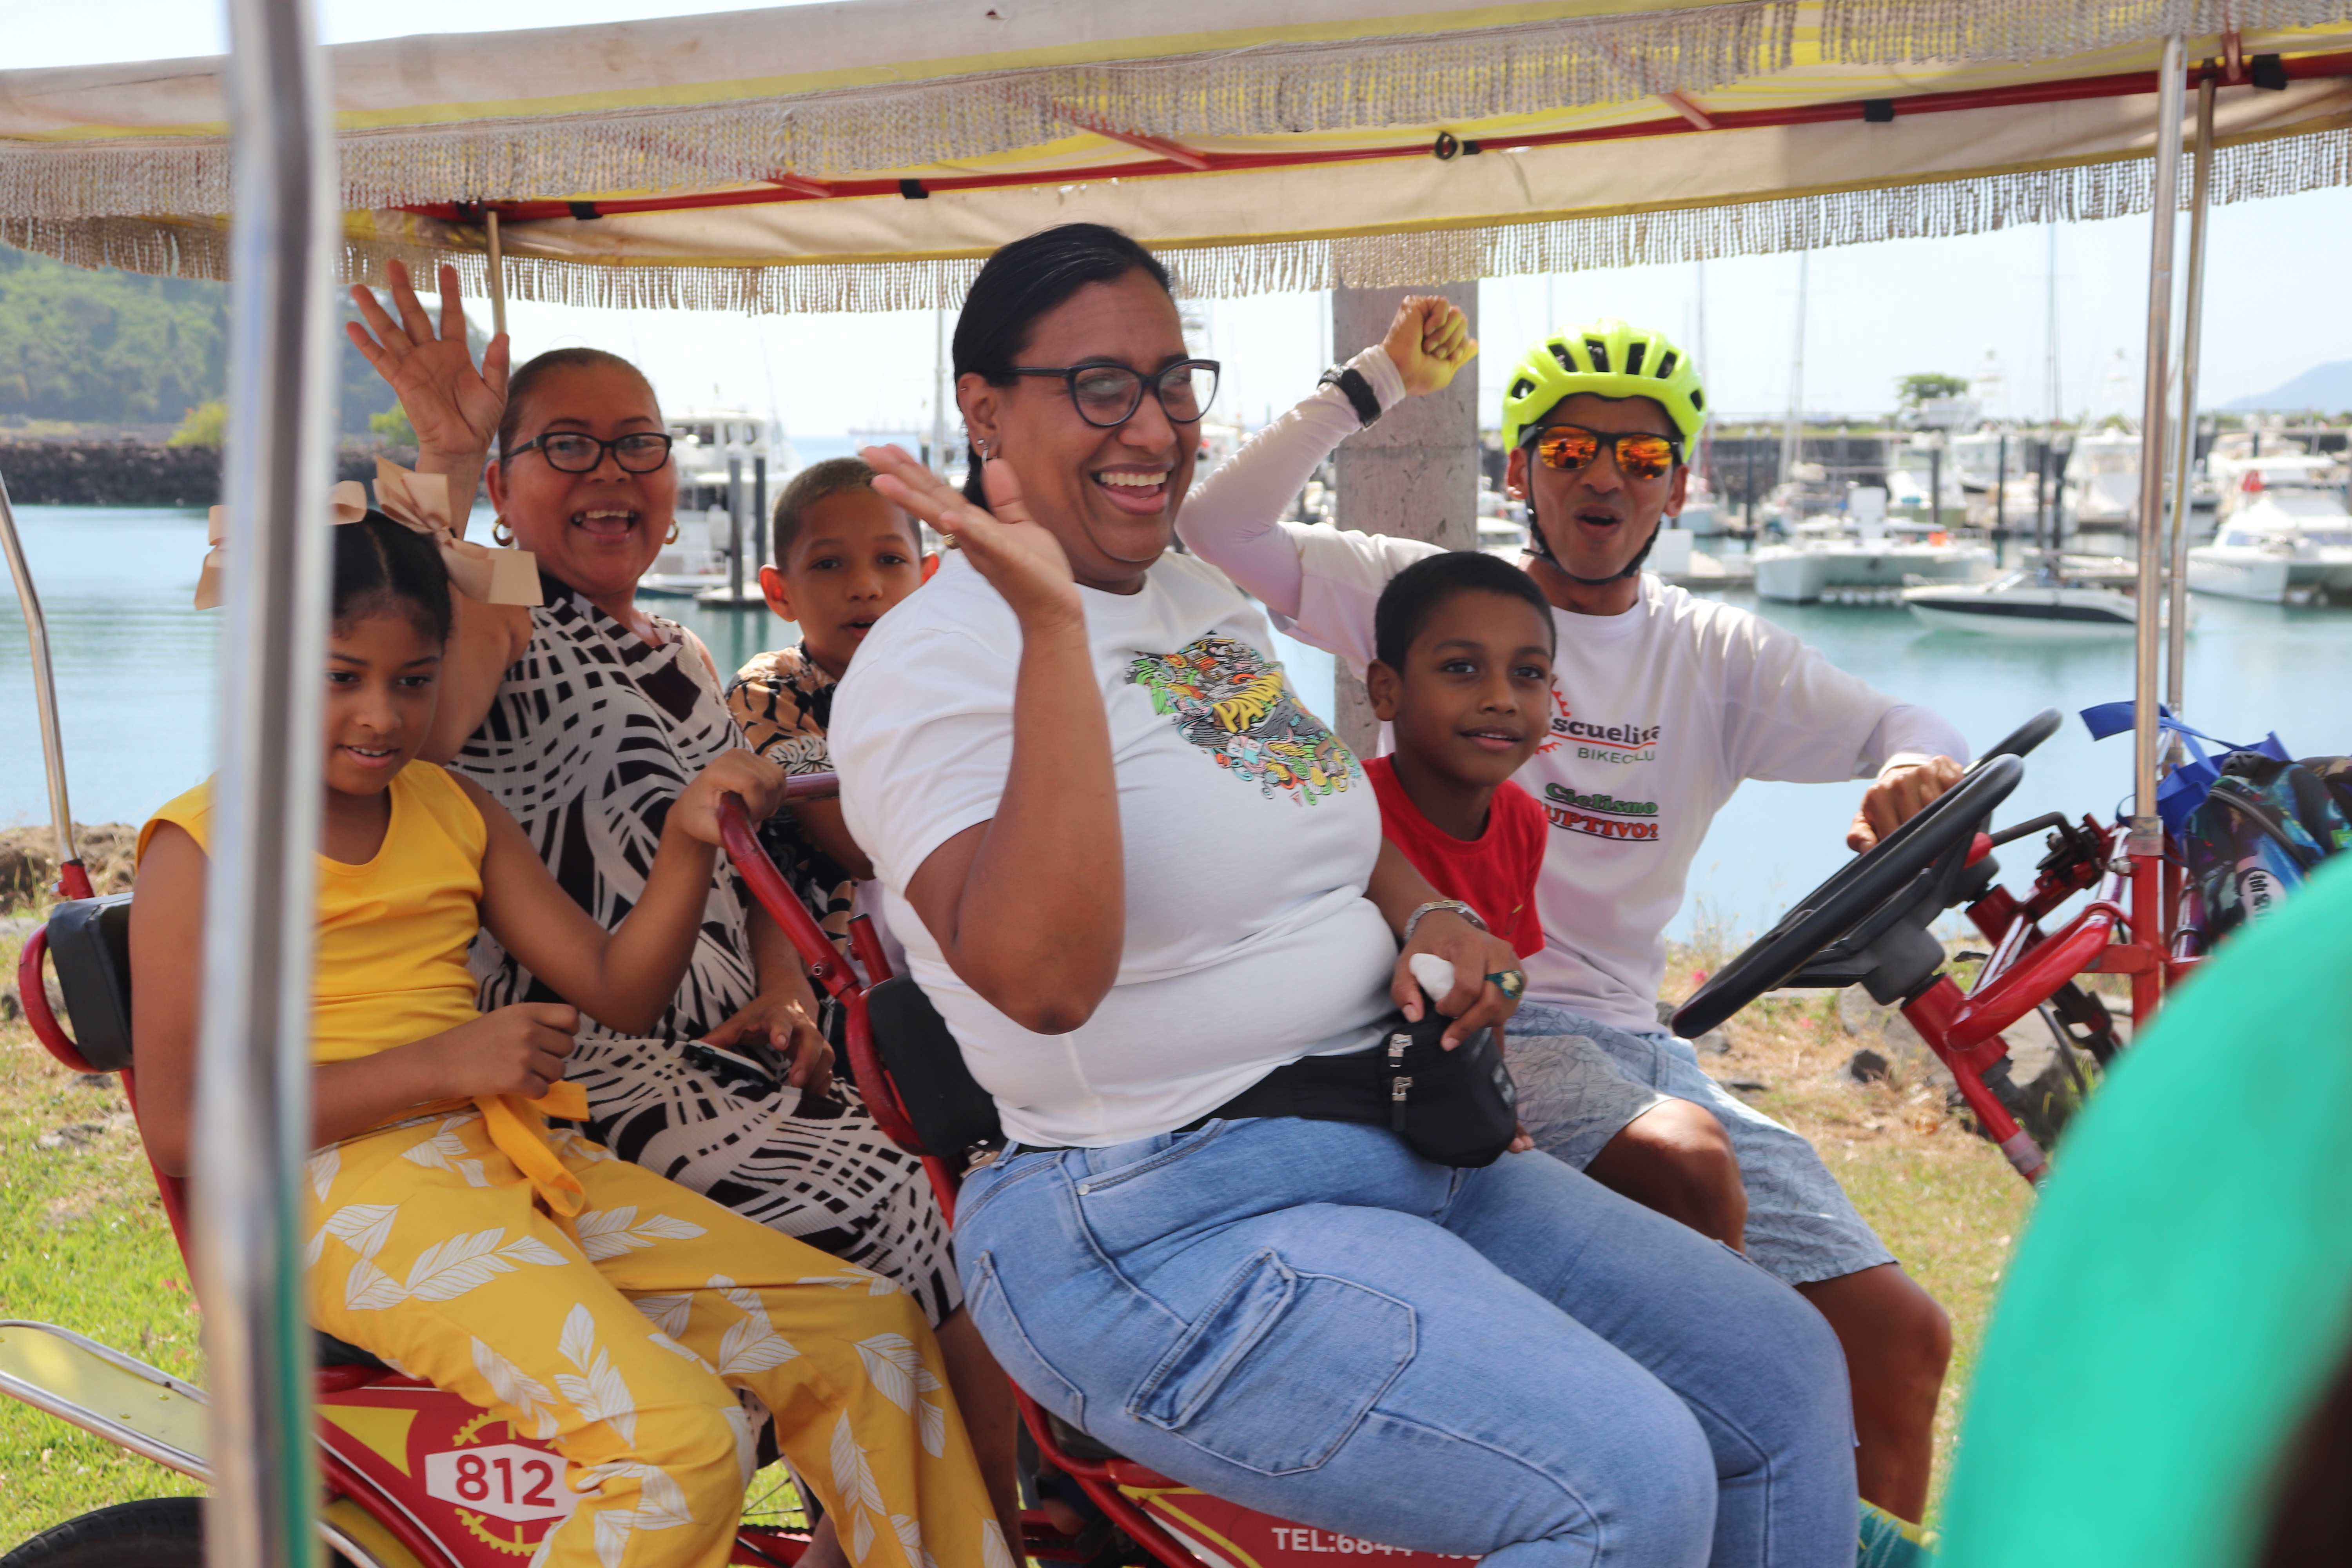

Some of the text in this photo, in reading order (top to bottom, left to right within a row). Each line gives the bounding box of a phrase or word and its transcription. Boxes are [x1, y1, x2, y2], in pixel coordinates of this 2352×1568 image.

[1550, 711, 1661, 744] scuelita
[1577, 747, 1655, 764] BIKECLU
[1546, 783, 1658, 814] Ciclismo
[1535, 799, 1659, 838] UPTIVO!
[456, 1454, 555, 1508] 812
